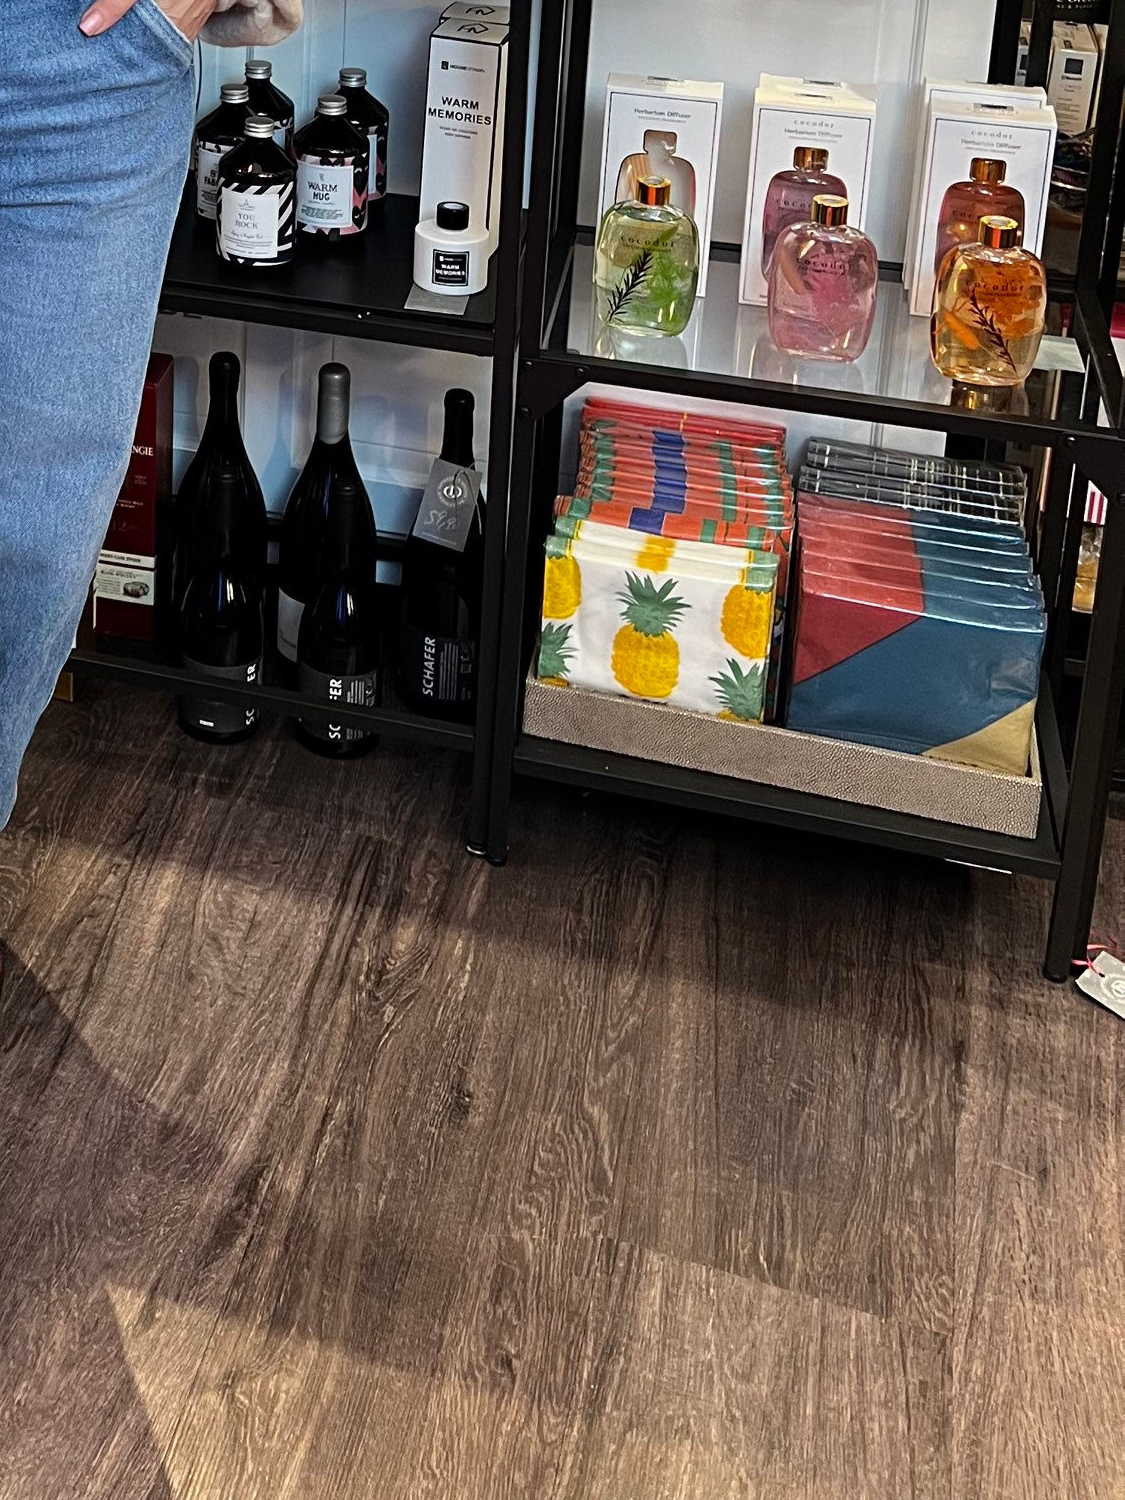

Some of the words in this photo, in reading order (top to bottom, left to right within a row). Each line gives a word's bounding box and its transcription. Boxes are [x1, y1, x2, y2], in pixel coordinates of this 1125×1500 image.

[441, 96, 479, 111] WARM
[428, 107, 492, 126] MEMORIES
[308, 181, 338, 193] WARM
[313, 192, 331, 201] HUG
[131, 445, 154, 457] NGIE
